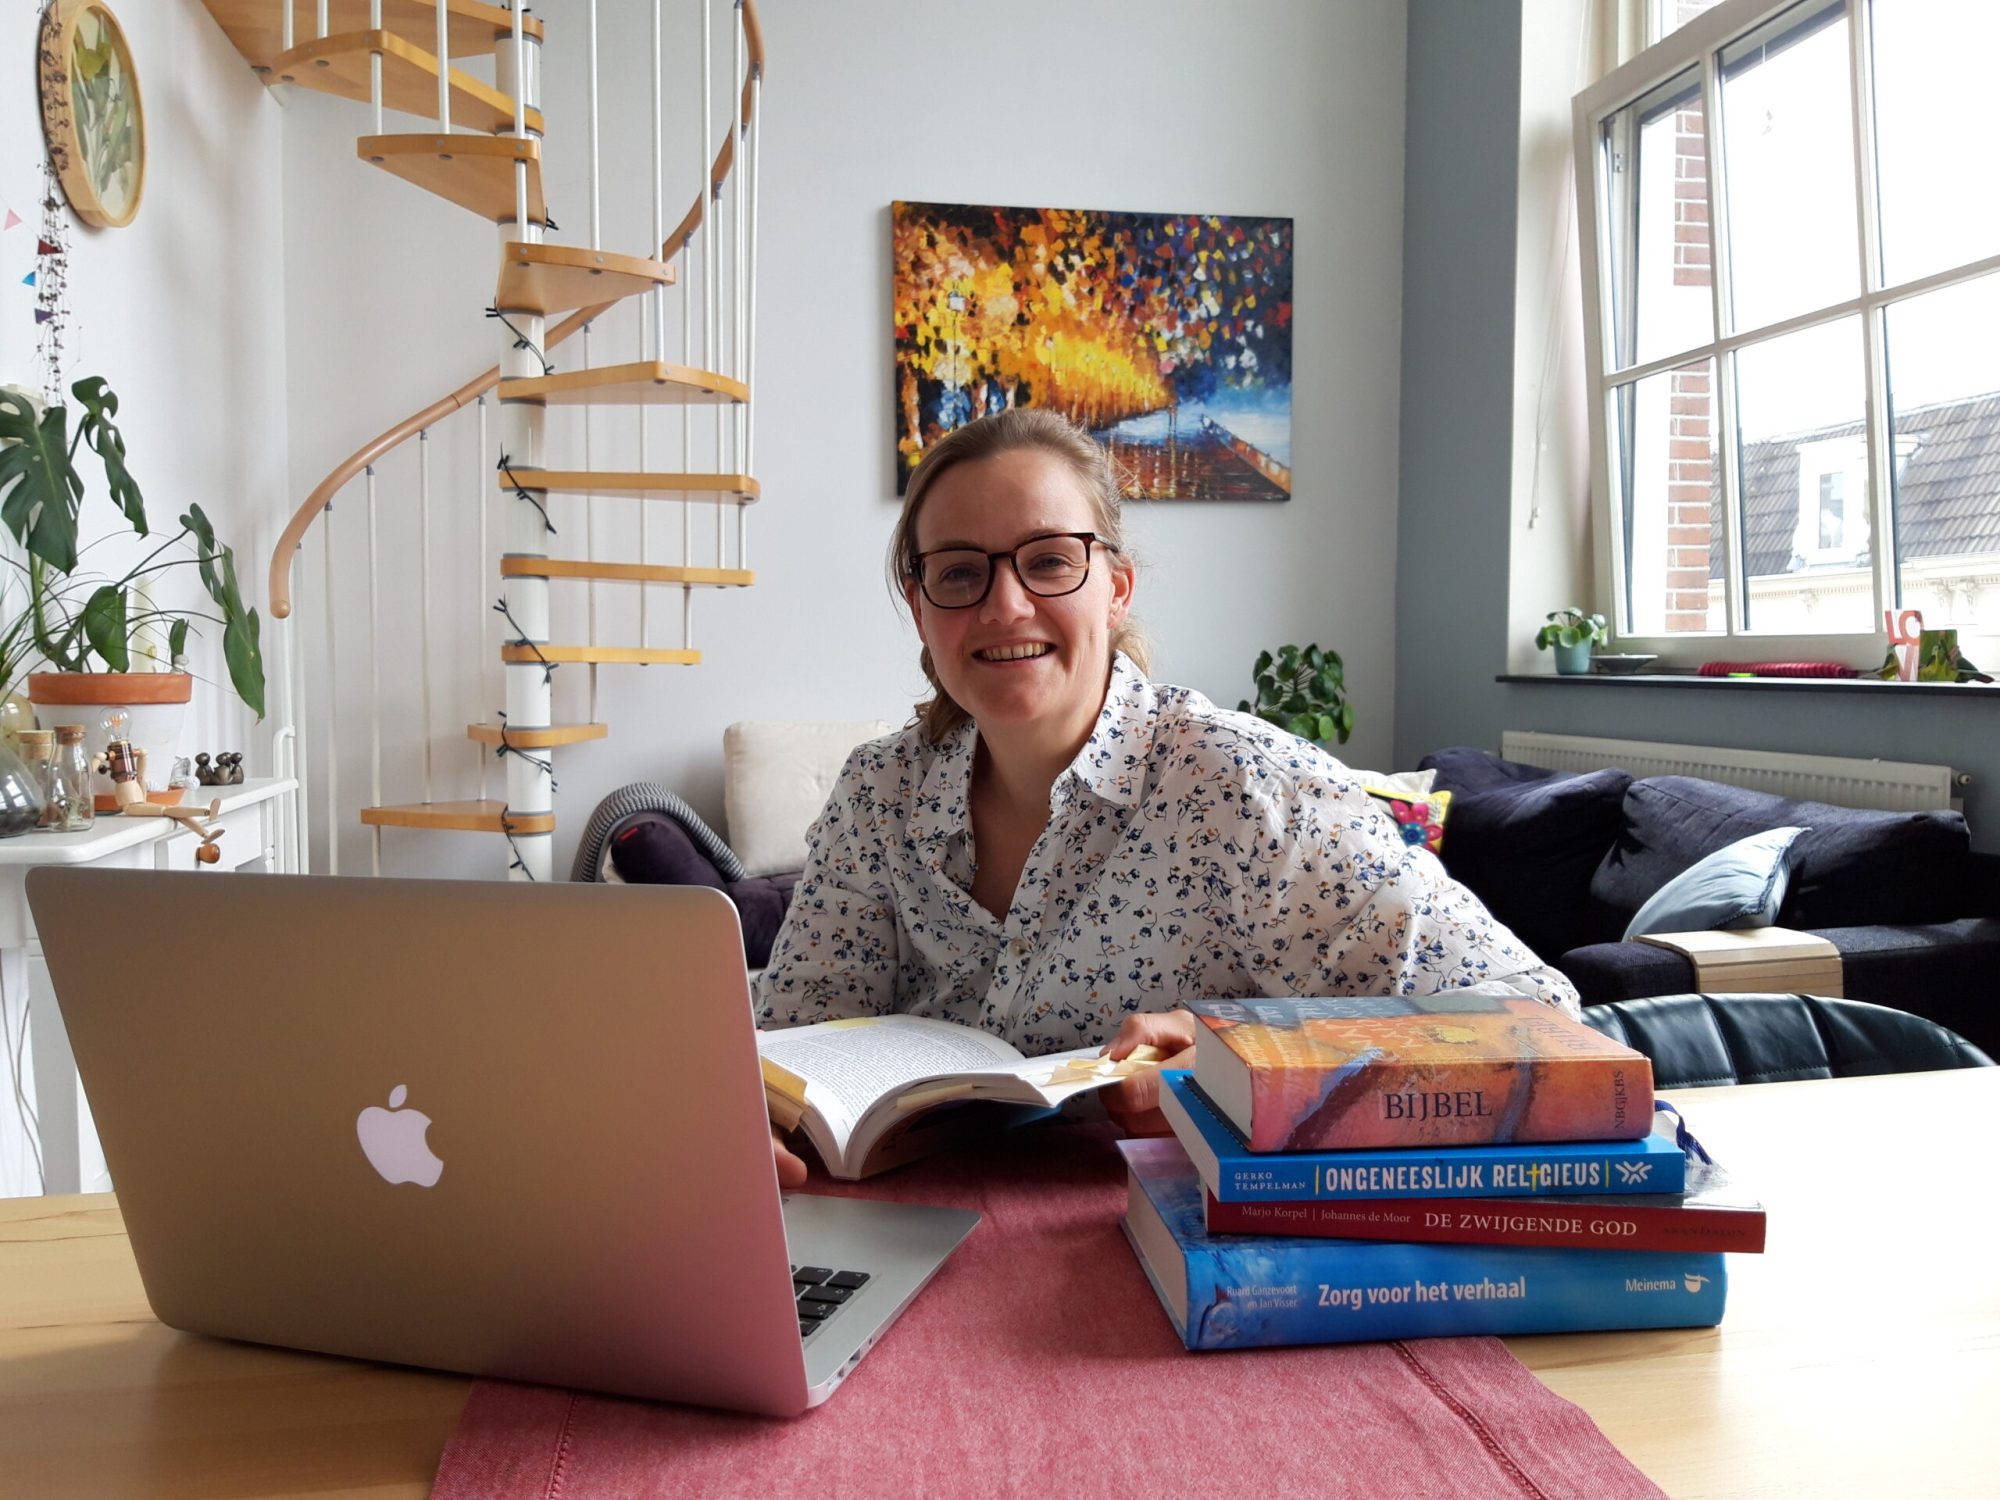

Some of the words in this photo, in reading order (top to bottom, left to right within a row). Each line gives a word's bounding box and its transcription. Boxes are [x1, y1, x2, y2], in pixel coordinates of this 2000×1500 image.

[1384, 1091, 1492, 1121] BIJBEL
[1234, 1171, 1273, 1181] GERKO
[1325, 1164, 1484, 1191] ONGENEESLIJK
[1234, 1181, 1306, 1191] TEMPELMAN
[1241, 1206, 1272, 1218] Marjo
[1274, 1207, 1308, 1219] Korpel
[1321, 1209, 1366, 1222] Johannes
[1368, 1211, 1381, 1222] de
[1383, 1213, 1411, 1223] Moor
[1424, 1212, 1452, 1228] DE
[1459, 1214, 1583, 1233] ZWIJGENDE
[1590, 1220, 1637, 1236] GOD
[1318, 1284, 1363, 1310] Zorg
[1367, 1285, 1412, 1304] voor
[1415, 1279, 1448, 1302] het
[1452, 1276, 1526, 1301] verhaal
[1625, 1278, 1677, 1292] Meinema
[1274, 1297, 1298, 1309] Visser
